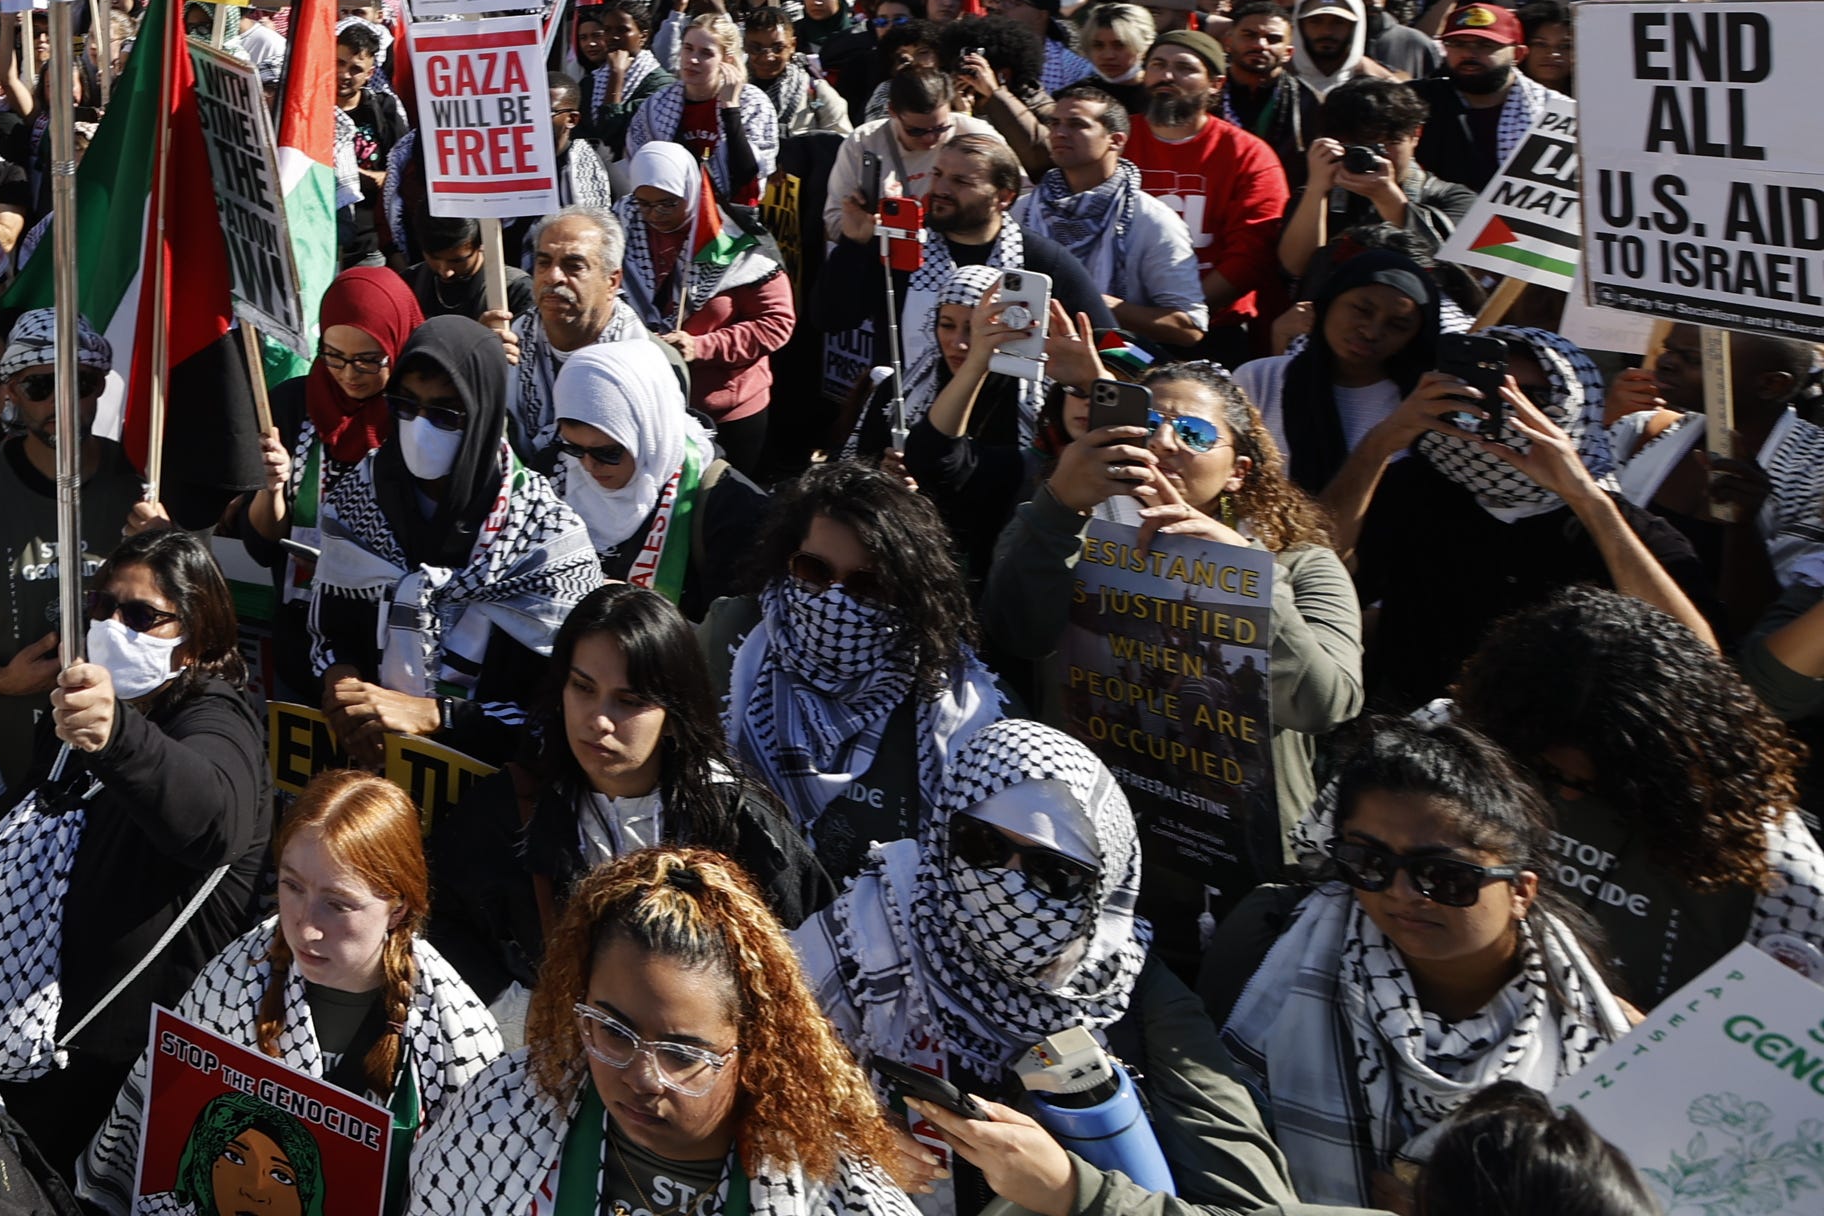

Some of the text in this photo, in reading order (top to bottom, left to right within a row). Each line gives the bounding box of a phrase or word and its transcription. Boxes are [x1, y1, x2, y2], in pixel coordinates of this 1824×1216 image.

[427, 50, 529, 97] GAZA
[1631, 11, 1772, 84] END
[198, 59, 253, 115] WITH
[431, 95, 534, 128] WILL BE
[434, 125, 539, 176] FREE
[1644, 85, 1766, 161] ALL
[213, 136, 275, 214] THE
[1597, 169, 1824, 252] U.S. AID
[1595, 232, 1644, 279] TO
[1619, 293, 1655, 311] Party
[1655, 298, 1675, 313] for
[1675, 302, 1743, 324] Socialism
[1743, 313, 1772, 329] and
[1083, 537, 1260, 598] ESISTANCE
[1098, 586, 1257, 645] JUSTIFIED
[1108, 632, 1204, 680] WHEN
[1070, 665, 1258, 745] PEOPLE ARE
[1088, 715, 1245, 785] OCCUPIED
[1556, 860, 1651, 917] OCIDE
[160, 1030, 381, 1152] STOP THE GENOCIDE
